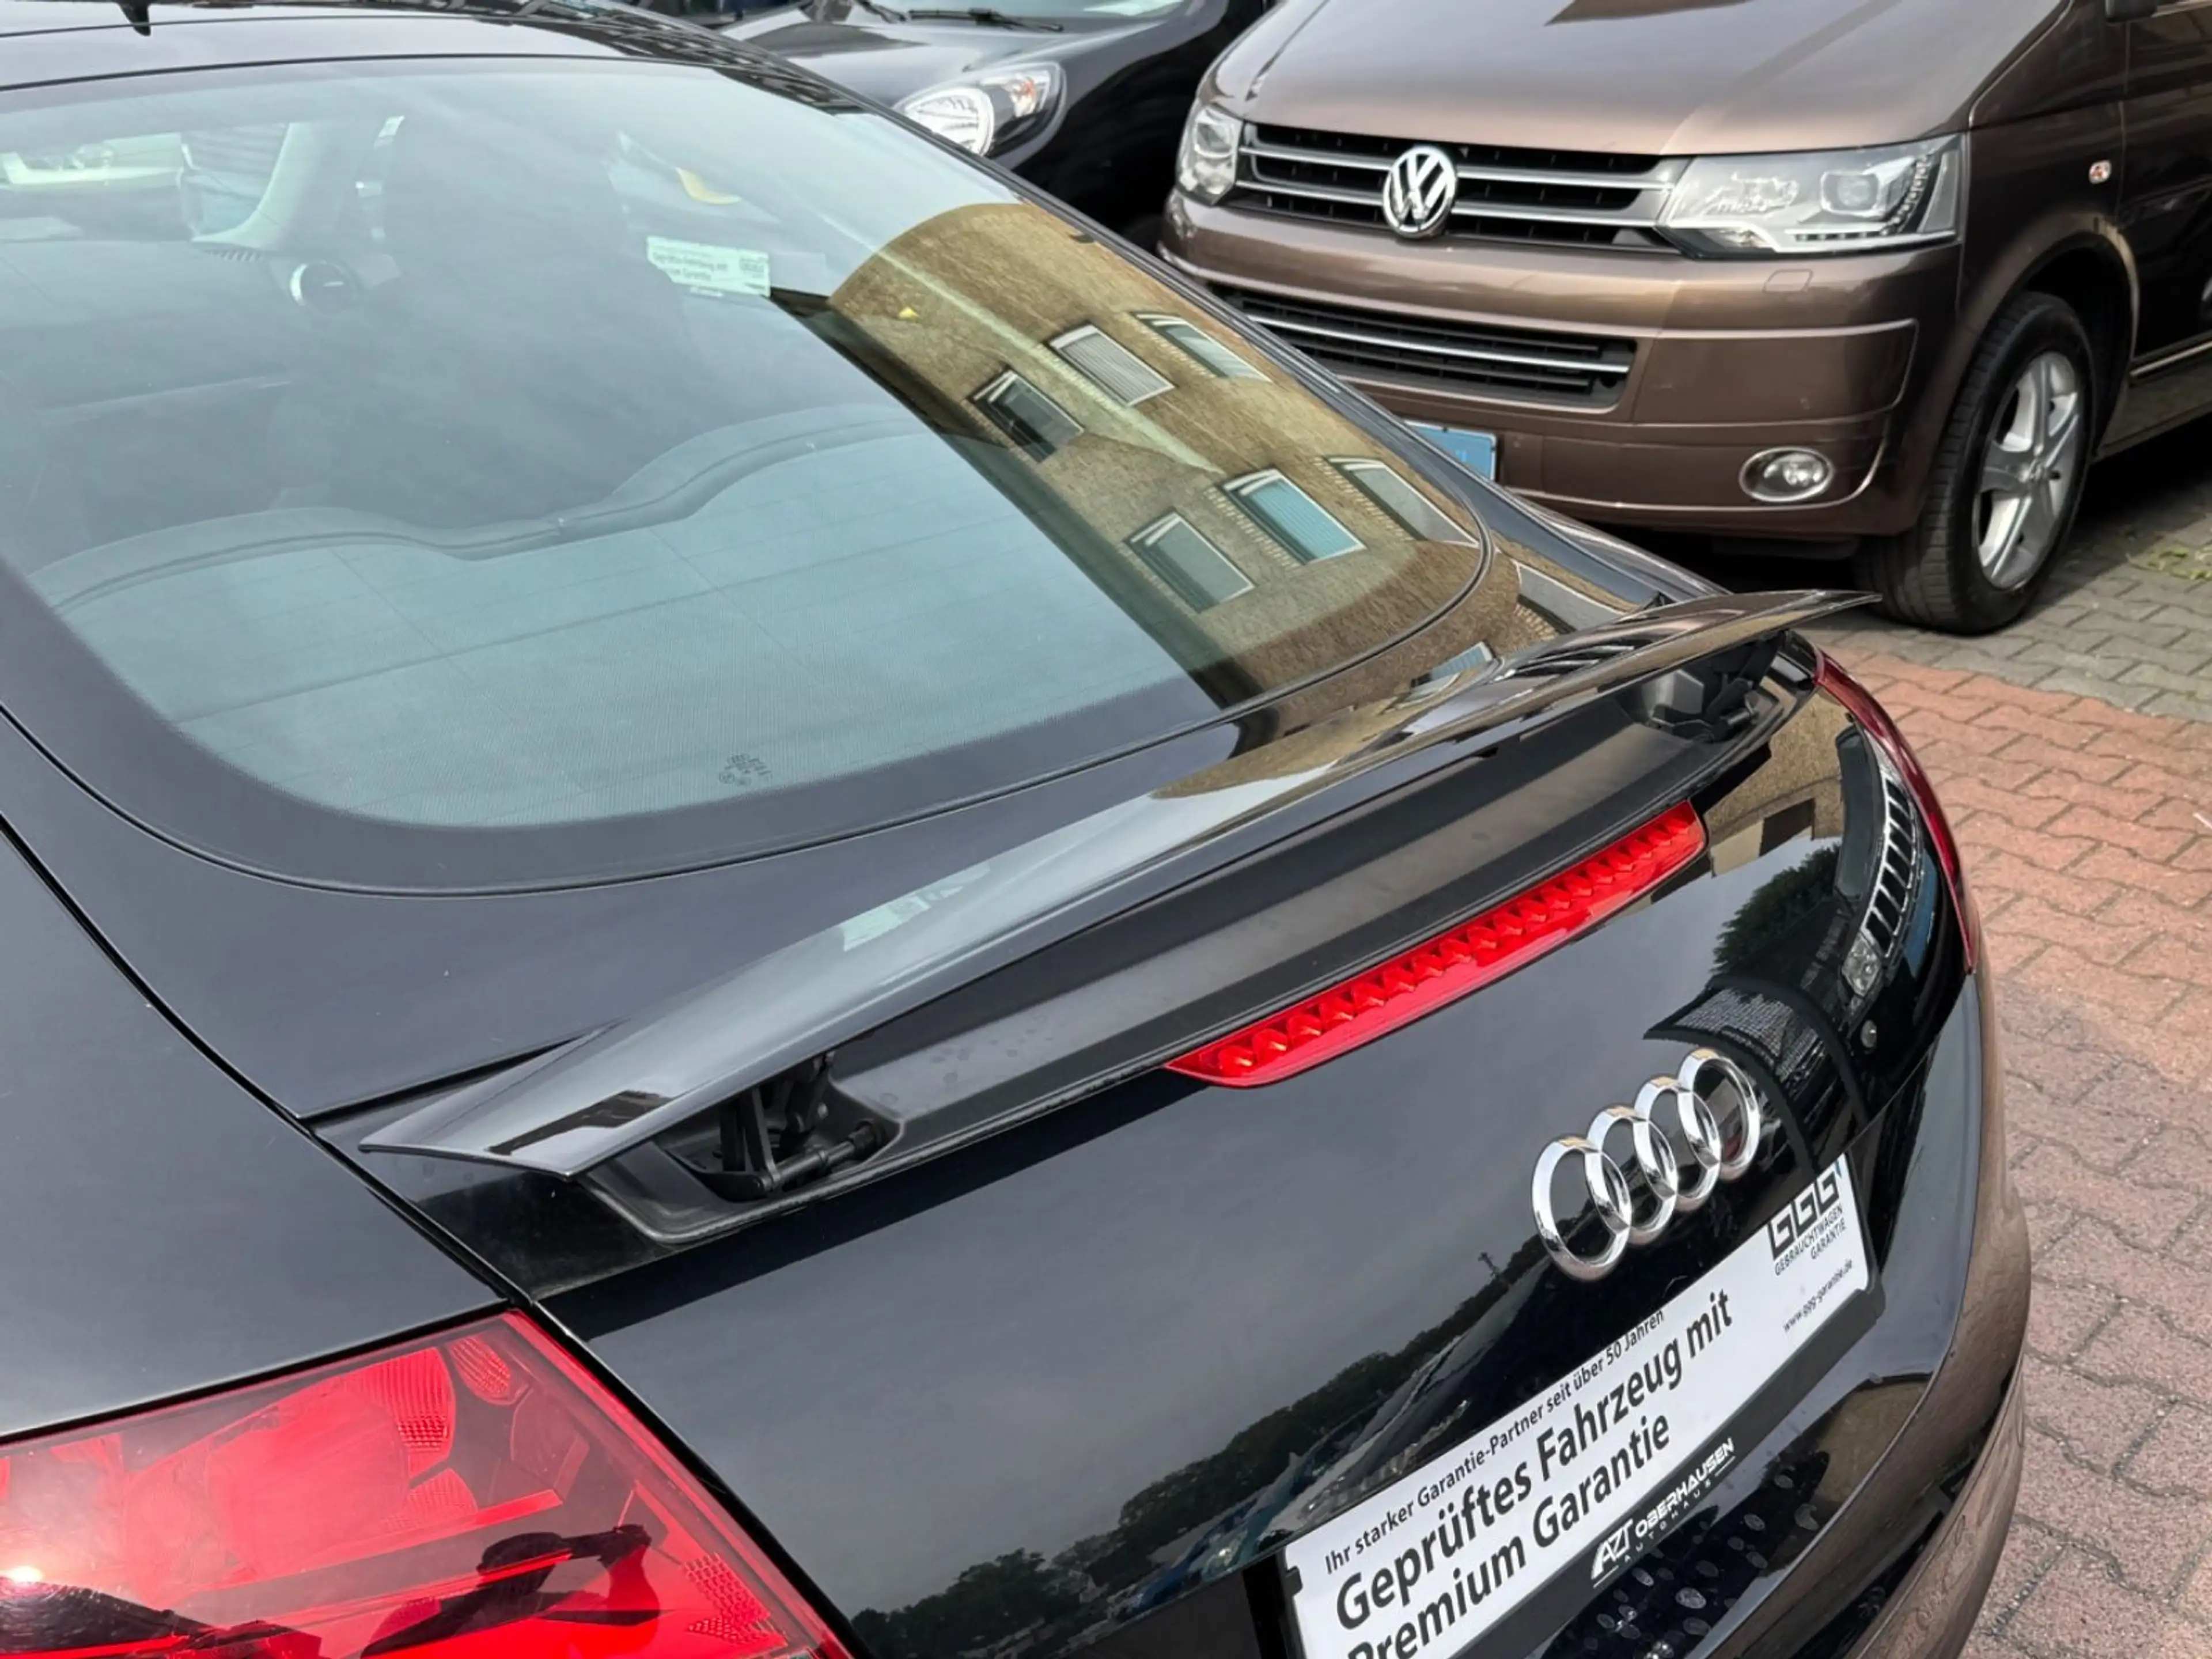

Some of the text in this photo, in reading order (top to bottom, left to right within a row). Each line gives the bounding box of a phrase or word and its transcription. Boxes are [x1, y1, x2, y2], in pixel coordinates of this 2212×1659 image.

[1384, 145, 1456, 238] VW
[1767, 1165, 1840, 1260] GGG
[1774, 1203, 1843, 1276] GEBRAUCHTWAGEN
[1810, 1218, 1846, 1260] GARANTIE
[1324, 1310, 1664, 1574] Ihr starker Garantie-Partner seit über 50 Jahren
[1336, 1288, 1732, 1630] Geprüftes Fahrzeug mit
[1533, 1415, 1670, 1548] Garantie
[1635, 1437, 1734, 1538] OBERHAUSEN
